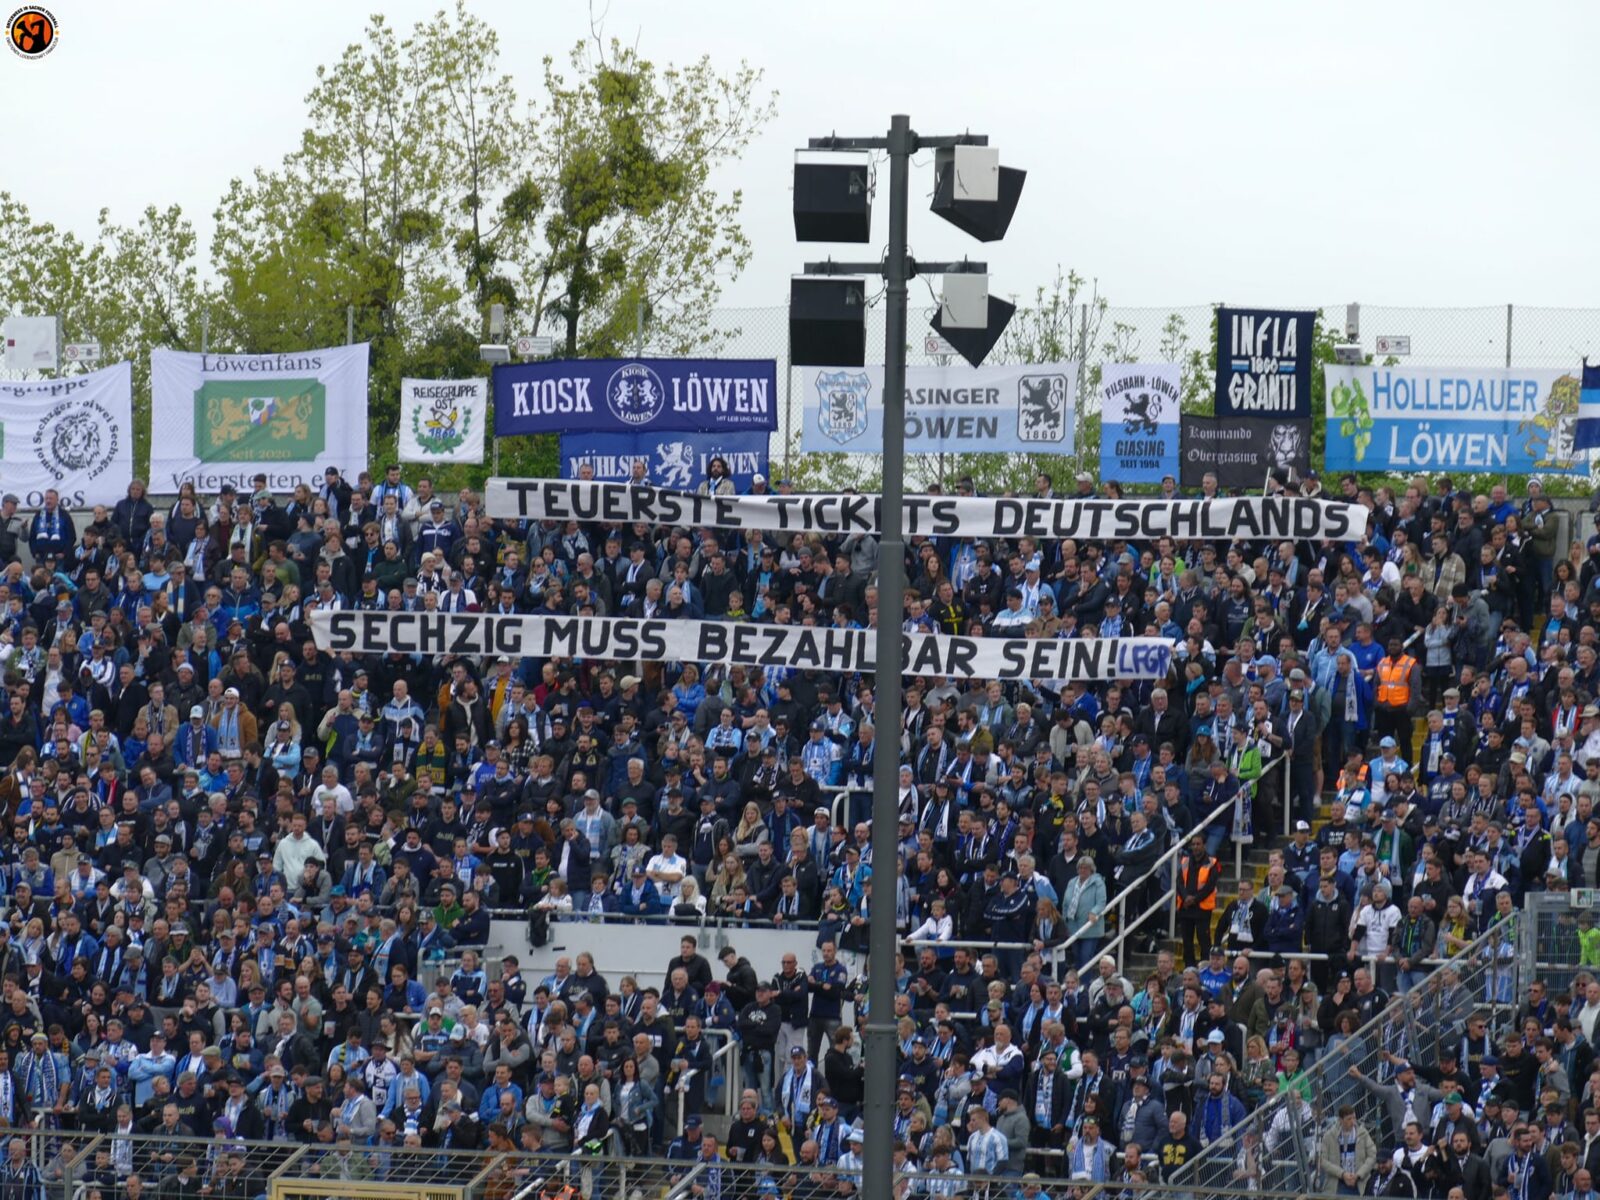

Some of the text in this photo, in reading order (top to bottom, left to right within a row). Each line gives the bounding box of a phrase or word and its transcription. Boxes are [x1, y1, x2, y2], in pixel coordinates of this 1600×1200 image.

[1231, 315, 1297, 357] INFLA
[201, 354, 322, 372] Löwenfans
[1250, 356, 1279, 375] 1860
[413, 385, 478, 399] REISEGRUPPE
[512, 372, 768, 417] KIOSK LÖWEN
[881, 388, 1000, 405] ASINGER
[1105, 375, 1179, 403] PILSHAHN LÖWEN
[1228, 372, 1297, 411] GRANTI
[1372, 371, 1538, 412] HOLLEDAUER
[435, 397, 456, 410] OST
[33, 401, 72, 445] Sechzger
[881, 411, 999, 440] ÖWEN
[428, 427, 456, 439] 1860
[1026, 430, 1056, 439] 1860
[1188, 425, 1252, 440] Kommando
[1115, 440, 1165, 457] GIASING
[1388, 422, 1509, 467] LÖWEN
[1120, 459, 1160, 468] SEIT 1994
[1187, 449, 1258, 465] Obergiasing
[172, 471, 302, 489] Vatersteten
[506, 481, 1350, 539] TEUERSTE TICKTS DEUTSCHLANDS
[330, 613, 523, 653] SECHZIG
[543, 618, 667, 659] MUSS
[998, 639, 1119, 679] SEIN!
